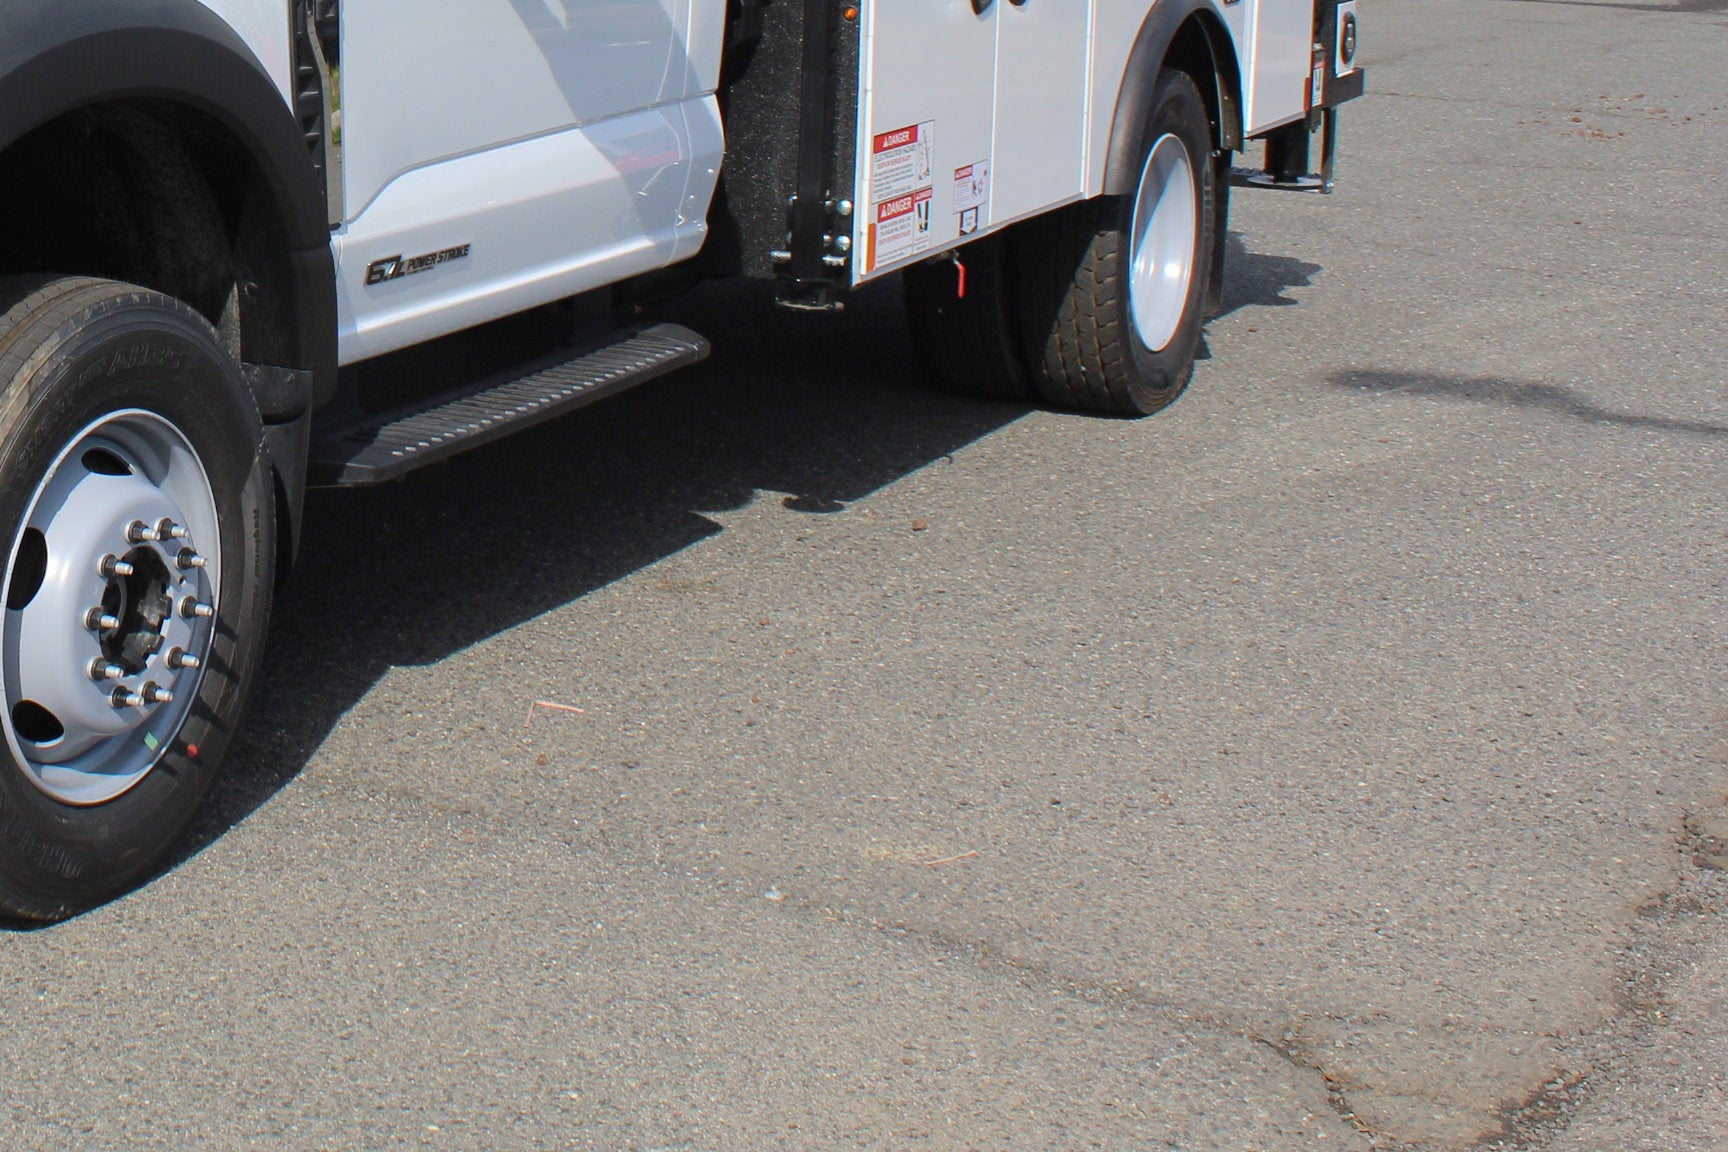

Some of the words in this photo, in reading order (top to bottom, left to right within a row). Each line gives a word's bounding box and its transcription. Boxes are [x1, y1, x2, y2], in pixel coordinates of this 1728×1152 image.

[887, 131, 910, 146] DANGER
[886, 197, 912, 216] DANGER
[407, 252, 436, 270] POWER
[436, 244, 470, 264] STROKE
